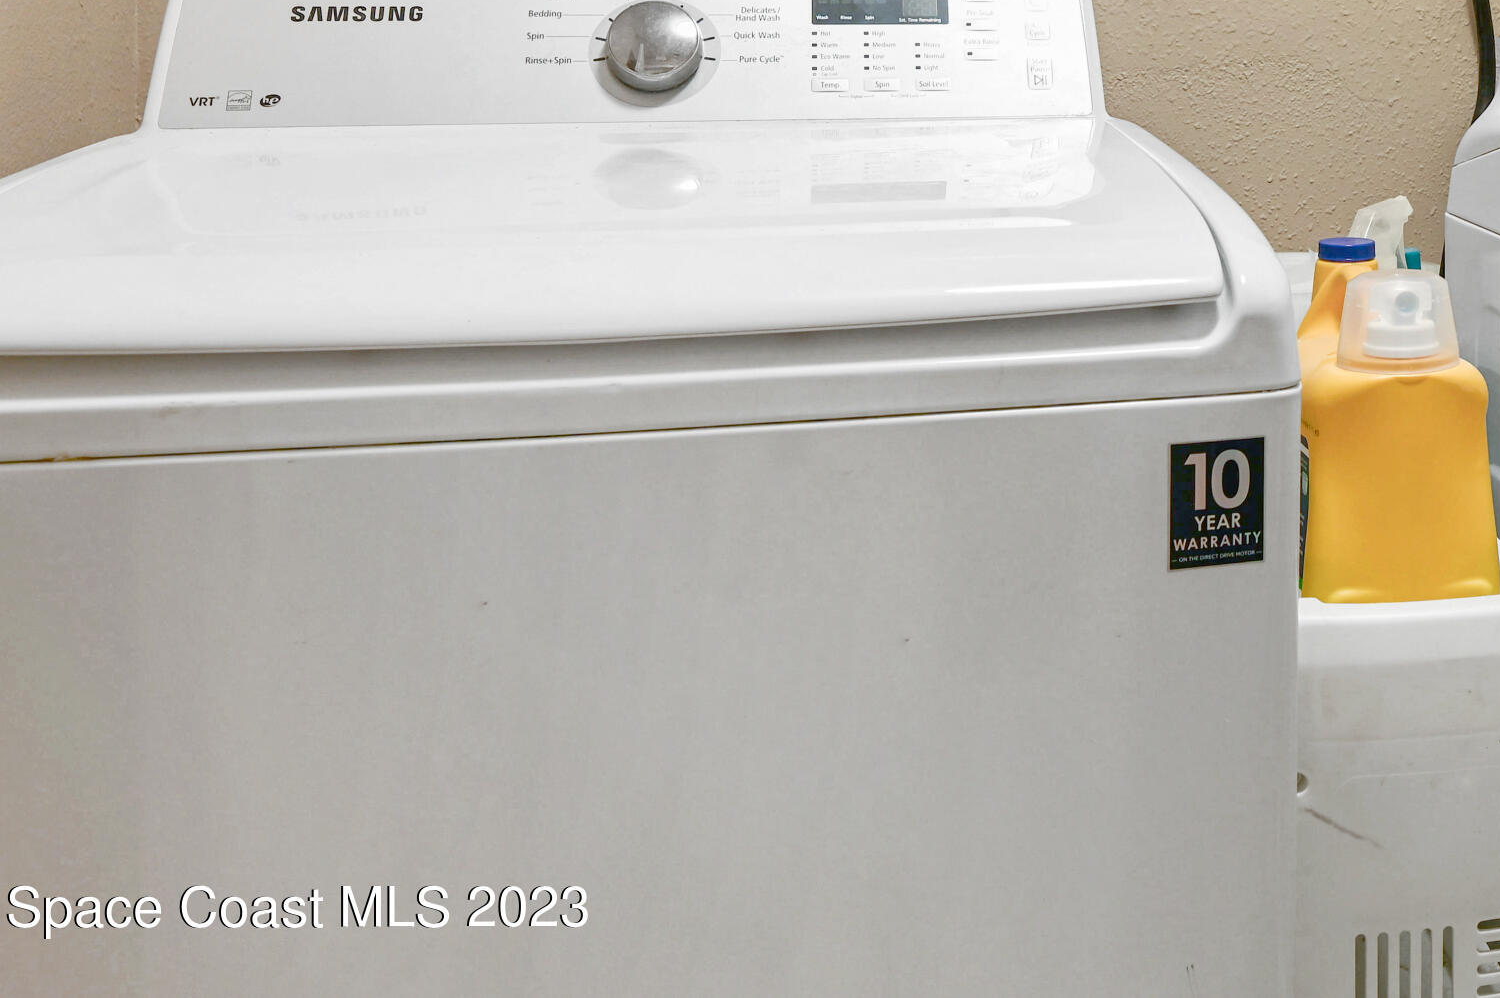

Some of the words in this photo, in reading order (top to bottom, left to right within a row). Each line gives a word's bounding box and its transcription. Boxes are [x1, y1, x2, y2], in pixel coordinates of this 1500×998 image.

[290, 5, 424, 23] SAMSUNG
[528, 9, 562, 19] Bedding
[735, 14, 757, 22] Hand
[759, 14, 781, 22] Wash
[526, 32, 545, 40] Spin
[734, 31, 756, 40] Quick
[759, 31, 781, 39] Wash
[525, 57, 572, 65] Rinse+Spin
[739, 55, 757, 63] Pure
[820, 81, 840, 89] Temp
[875, 81, 890, 89] Spin
[1184, 448, 1251, 511] 10
[1194, 512, 1241, 532] YEAR
[1173, 531, 1261, 552] WARRANTY
[1189, 554, 1199, 562] THE
[1199, 553, 1218, 561] DIRECT
[1219, 551, 1235, 559] DRIVE
[1236, 549, 1256, 557] MOTOR
